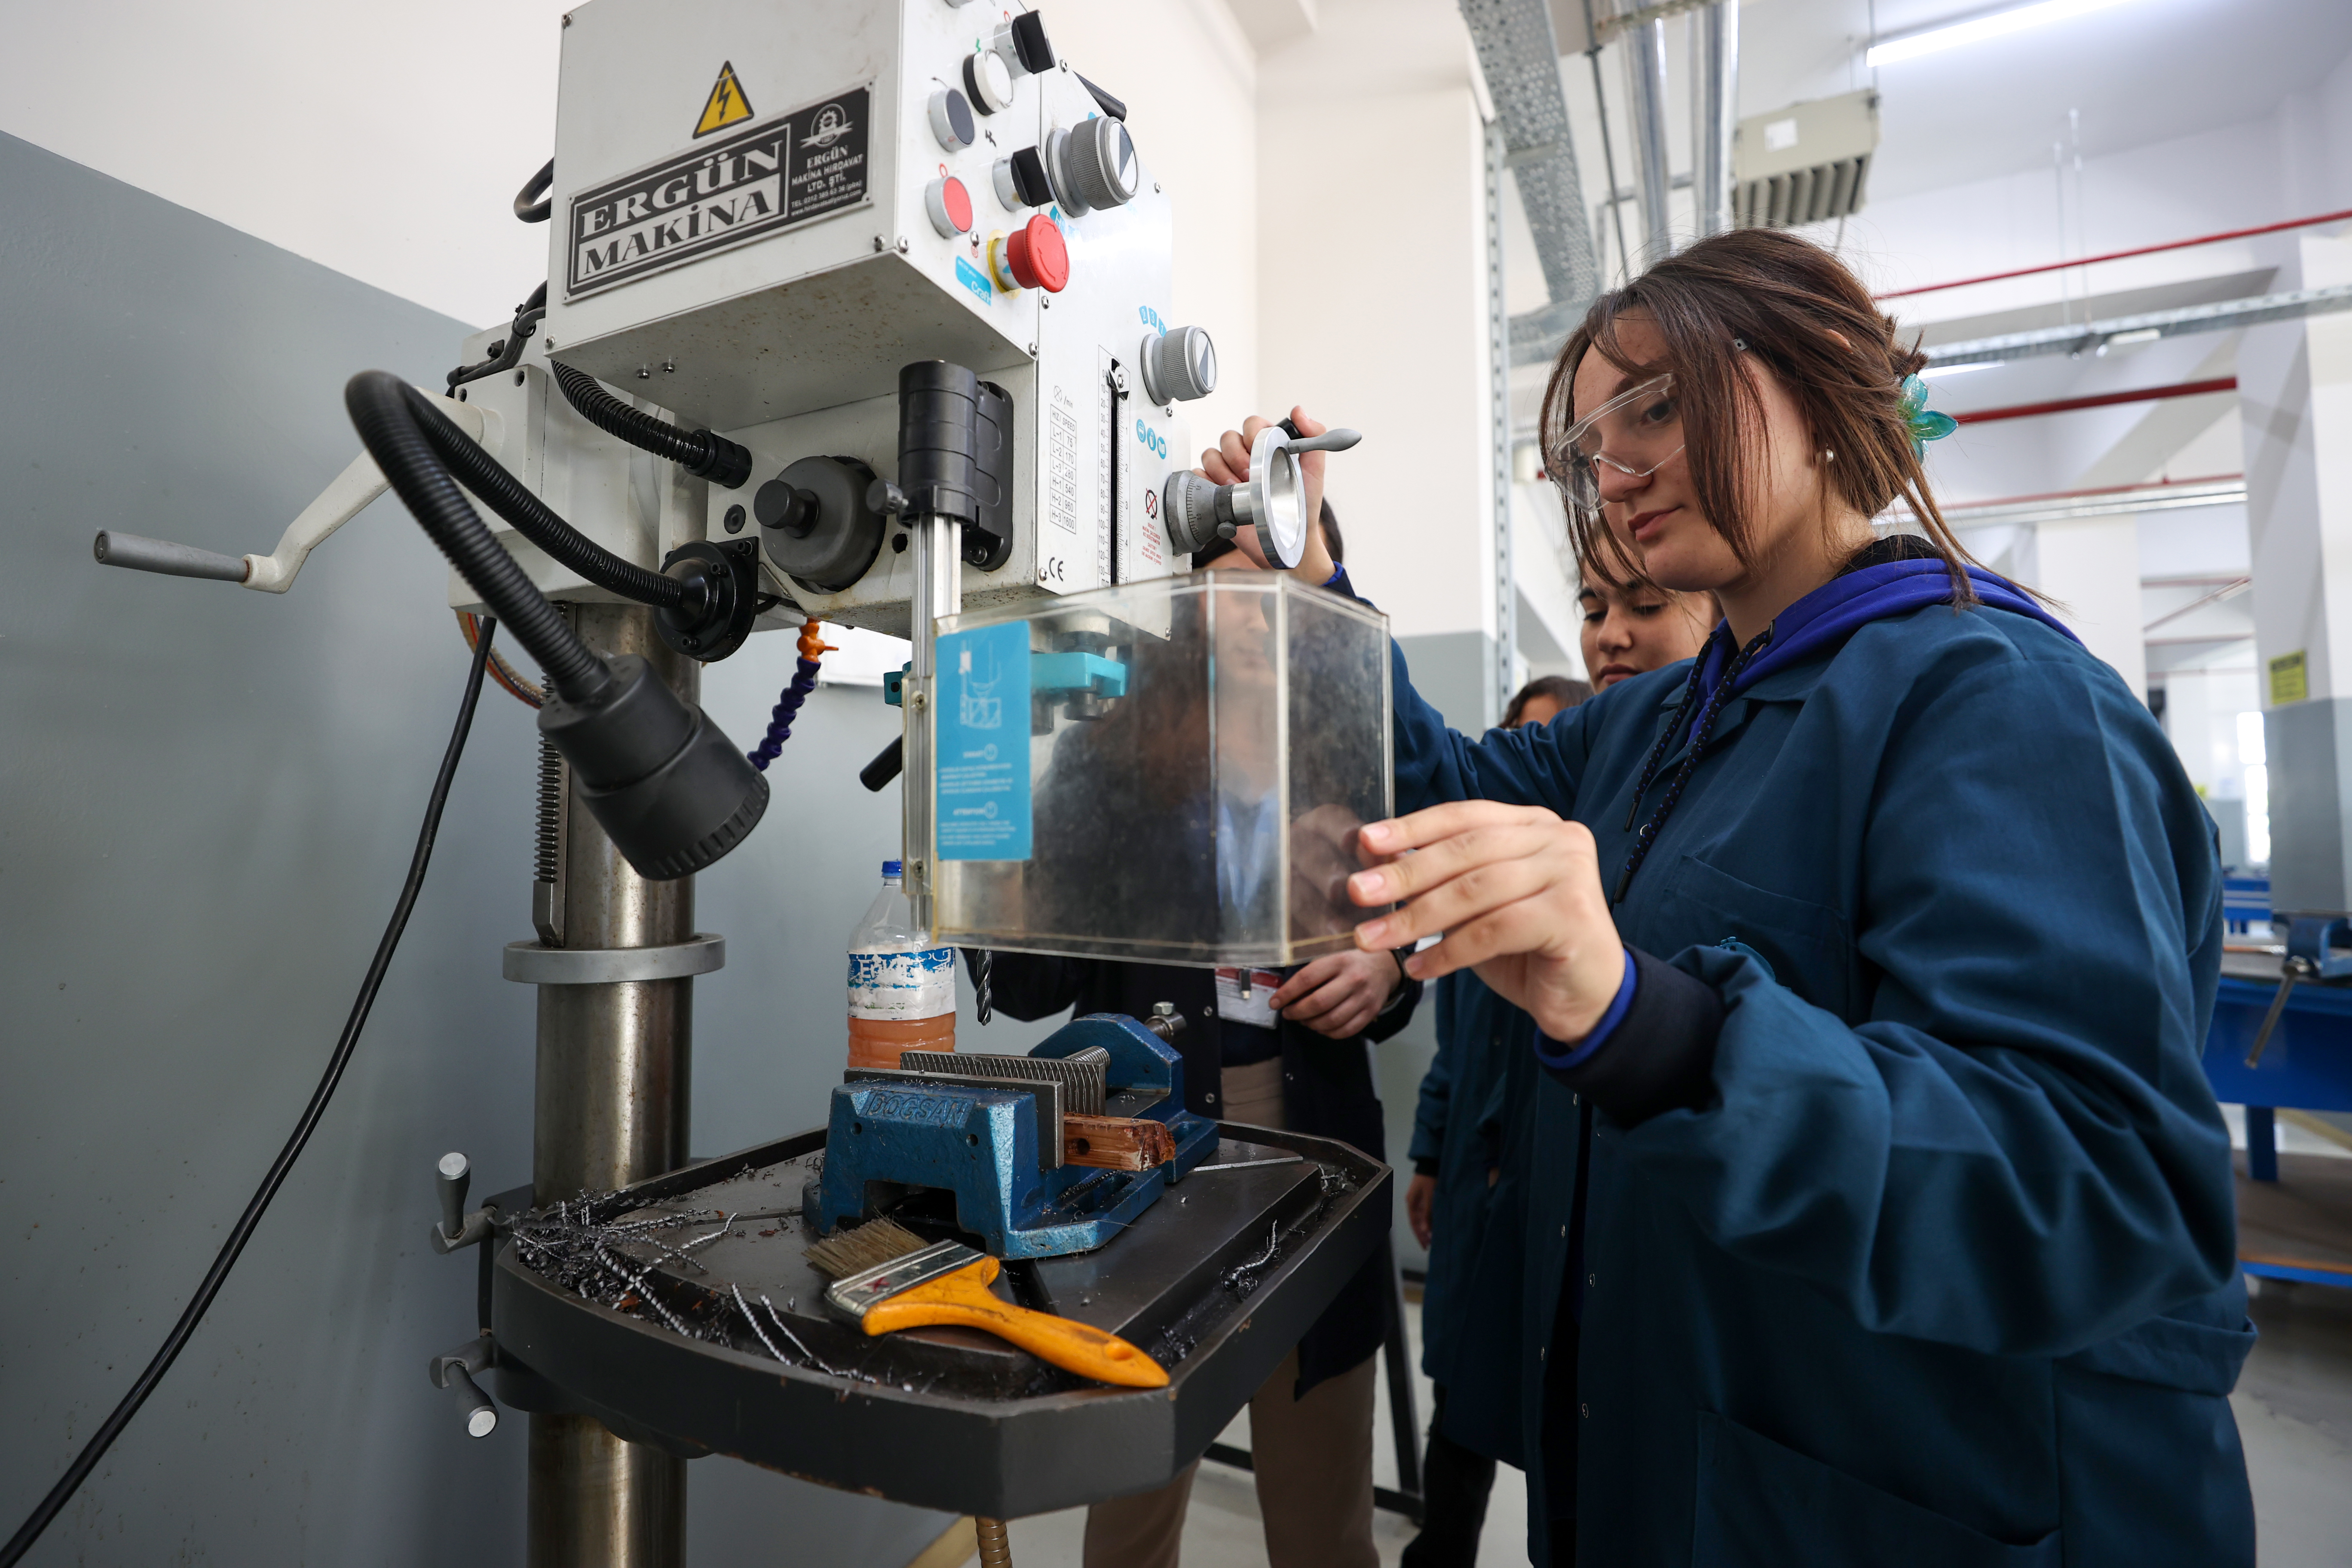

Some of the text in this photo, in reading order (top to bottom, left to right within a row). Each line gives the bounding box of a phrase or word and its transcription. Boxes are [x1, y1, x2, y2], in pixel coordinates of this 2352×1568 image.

[807, 145, 848, 169] ERGÜN
[792, 153, 864, 186] MAKİNA HIRDAVAT
[581, 140, 783, 238] ERGÜN
[807, 180, 826, 193] LTD.
[584, 190, 772, 274] MAKİNA
[1141, 308, 1147, 321] 2
[1151, 311, 1155, 323] 3
[1101, 383, 1105, 393] 10
[1101, 398, 1105, 408] 20
[1101, 413, 1105, 423] 30
[1063, 417, 1075, 432] SPEED
[1053, 426, 1062, 441] L-1
[1101, 429, 1105, 438] 40
[1067, 436, 1073, 447] 75
[1053, 443, 1062, 457] L-2
[1101, 443, 1105, 453] 50
[1066, 452, 1074, 464] 170
[1101, 459, 1105, 469] 60
[1053, 459, 1061, 473] L-3
[1125, 464, 1128, 472] 2
[1065, 468, 1074, 480] 280
[1101, 474, 1105, 484] 70
[1053, 476, 1061, 489] H-1
[1065, 484, 1074, 496] 540
[1101, 489, 1105, 499] 80
[1052, 492, 1061, 506] H-2
[1065, 500, 1073, 512] 960
[1101, 504, 1105, 514] 90
[1125, 501, 1128, 510] 3
[1052, 509, 1061, 522] H-3
[1063, 516, 1074, 529] 1600
[1125, 539, 1128, 548] 4
